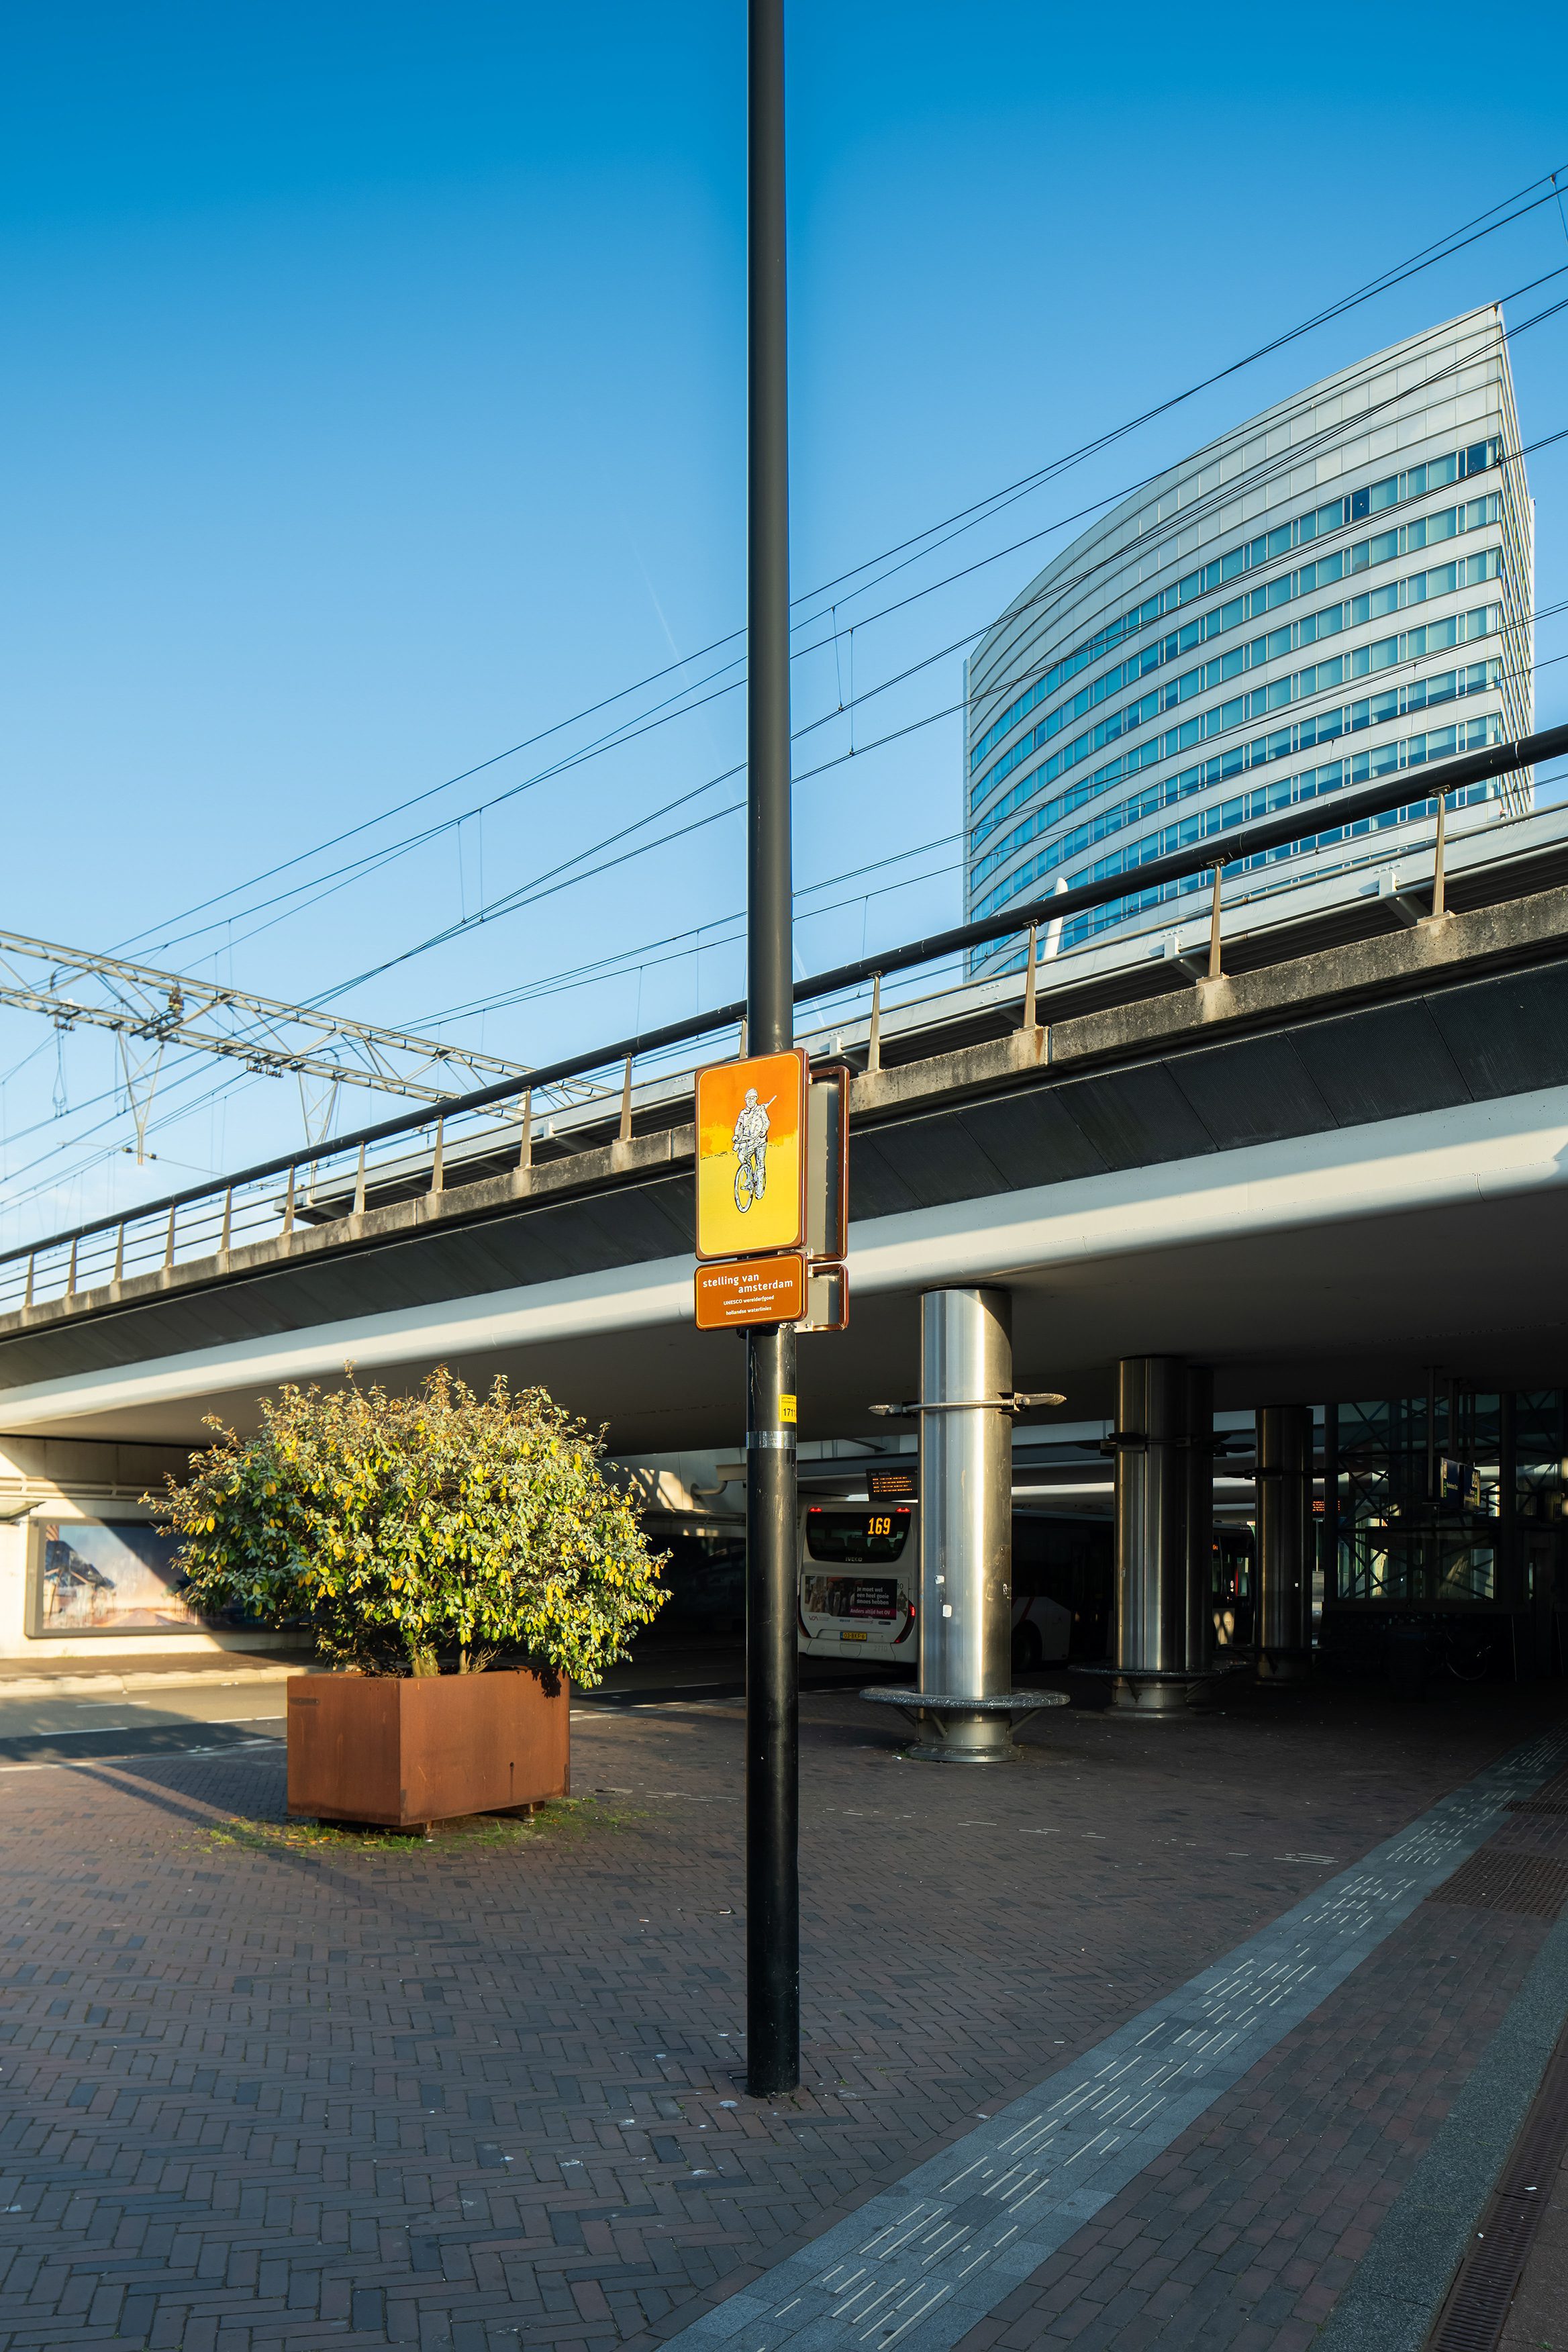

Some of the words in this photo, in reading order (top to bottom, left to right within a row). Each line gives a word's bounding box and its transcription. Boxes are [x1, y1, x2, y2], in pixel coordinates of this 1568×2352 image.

[703, 1276, 739, 1287] stelling
[742, 1274, 759, 1283] van
[738, 1279, 793, 1293] amsterdam
[743, 1295, 775, 1304] werelderfgoed
[747, 1306, 772, 1314] waterlinies
[868, 1518, 891, 1535] 169
